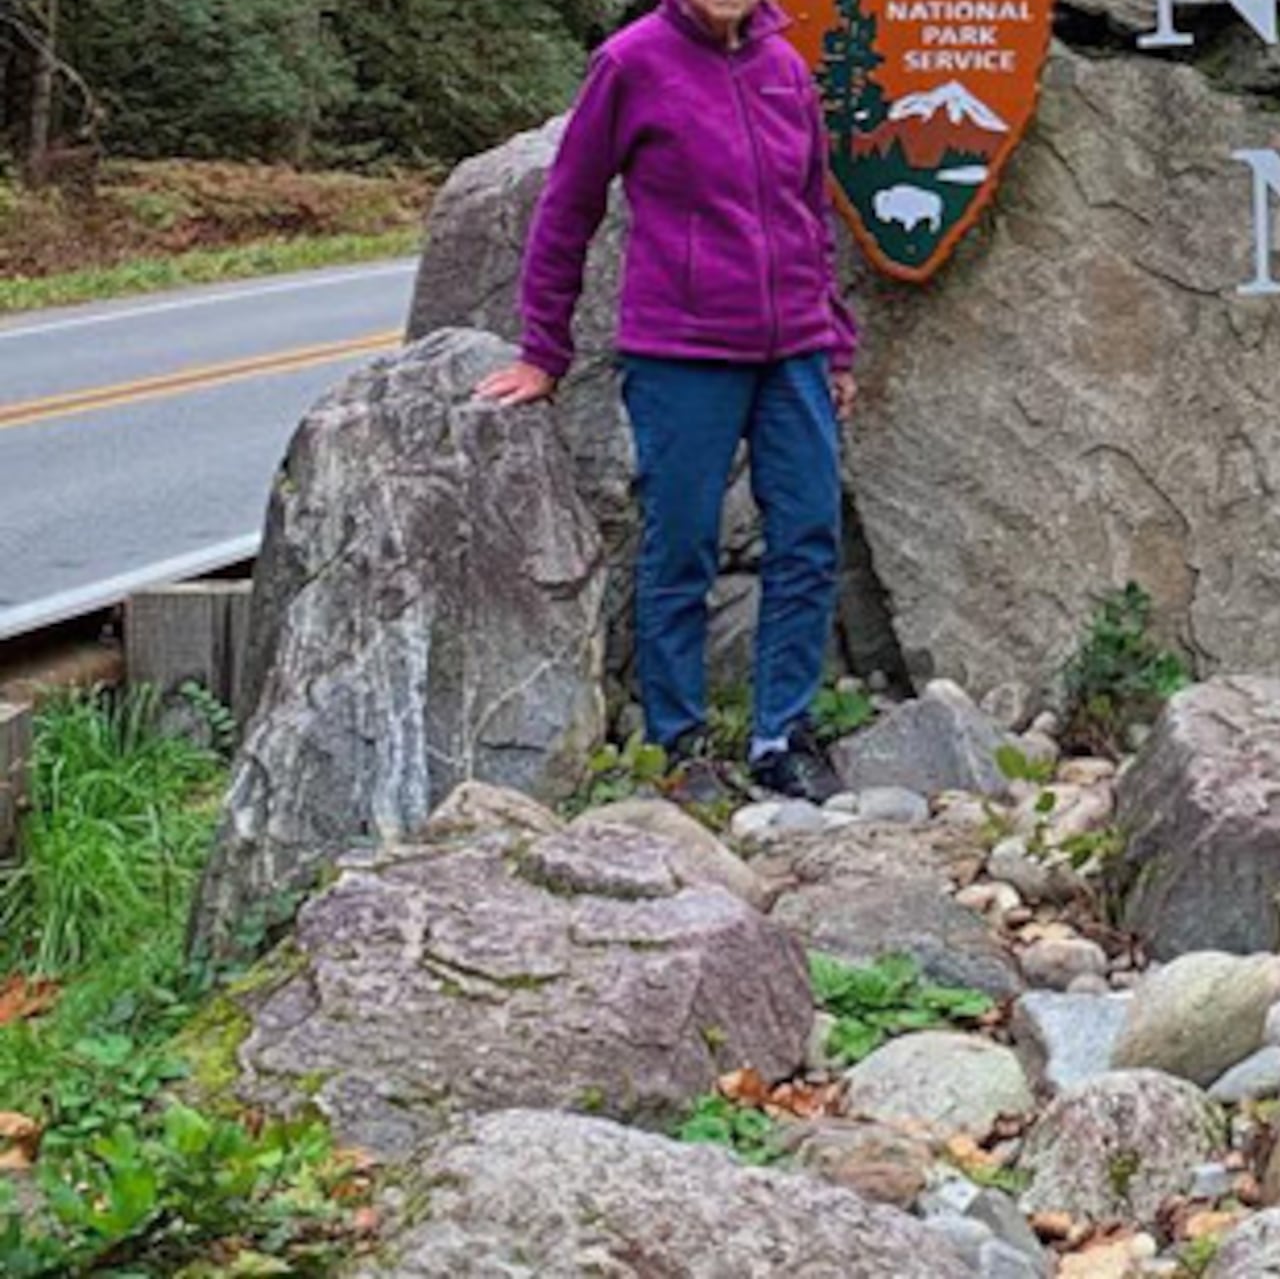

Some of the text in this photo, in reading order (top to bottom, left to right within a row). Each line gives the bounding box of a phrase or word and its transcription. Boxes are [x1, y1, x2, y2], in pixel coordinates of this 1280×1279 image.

[886, 1, 1032, 20] NATIONAL
[921, 26, 997, 46] PARK
[904, 51, 1014, 71] SERVICE
